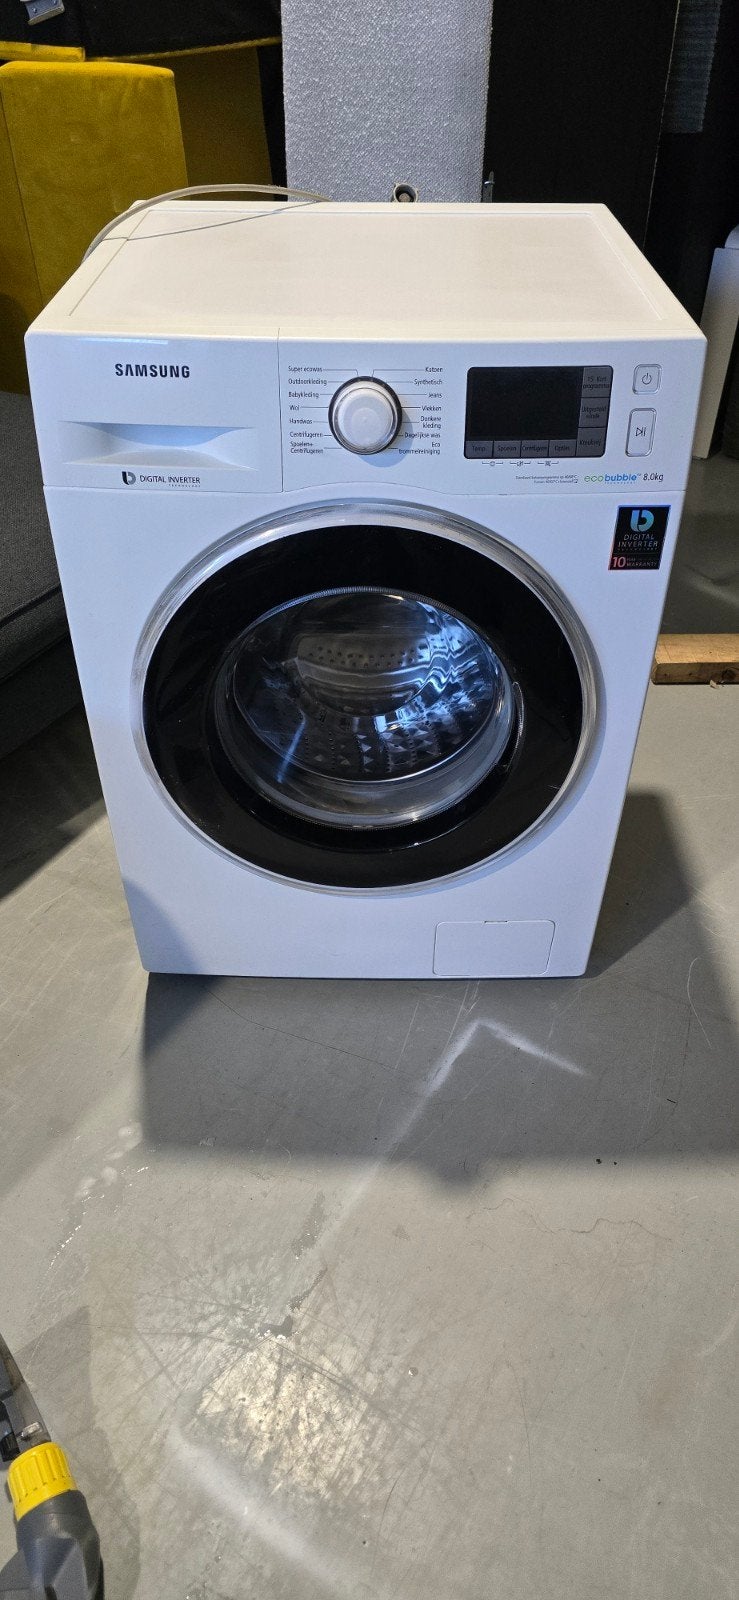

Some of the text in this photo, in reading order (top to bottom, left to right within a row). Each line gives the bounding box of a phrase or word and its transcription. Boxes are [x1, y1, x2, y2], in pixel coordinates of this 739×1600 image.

[115, 363, 190, 378] SAMSUNG
[140, 475, 166, 483] DIGITAL
[643, 473, 664, 482] 8.0kg
[612, 556, 626, 568] 10
